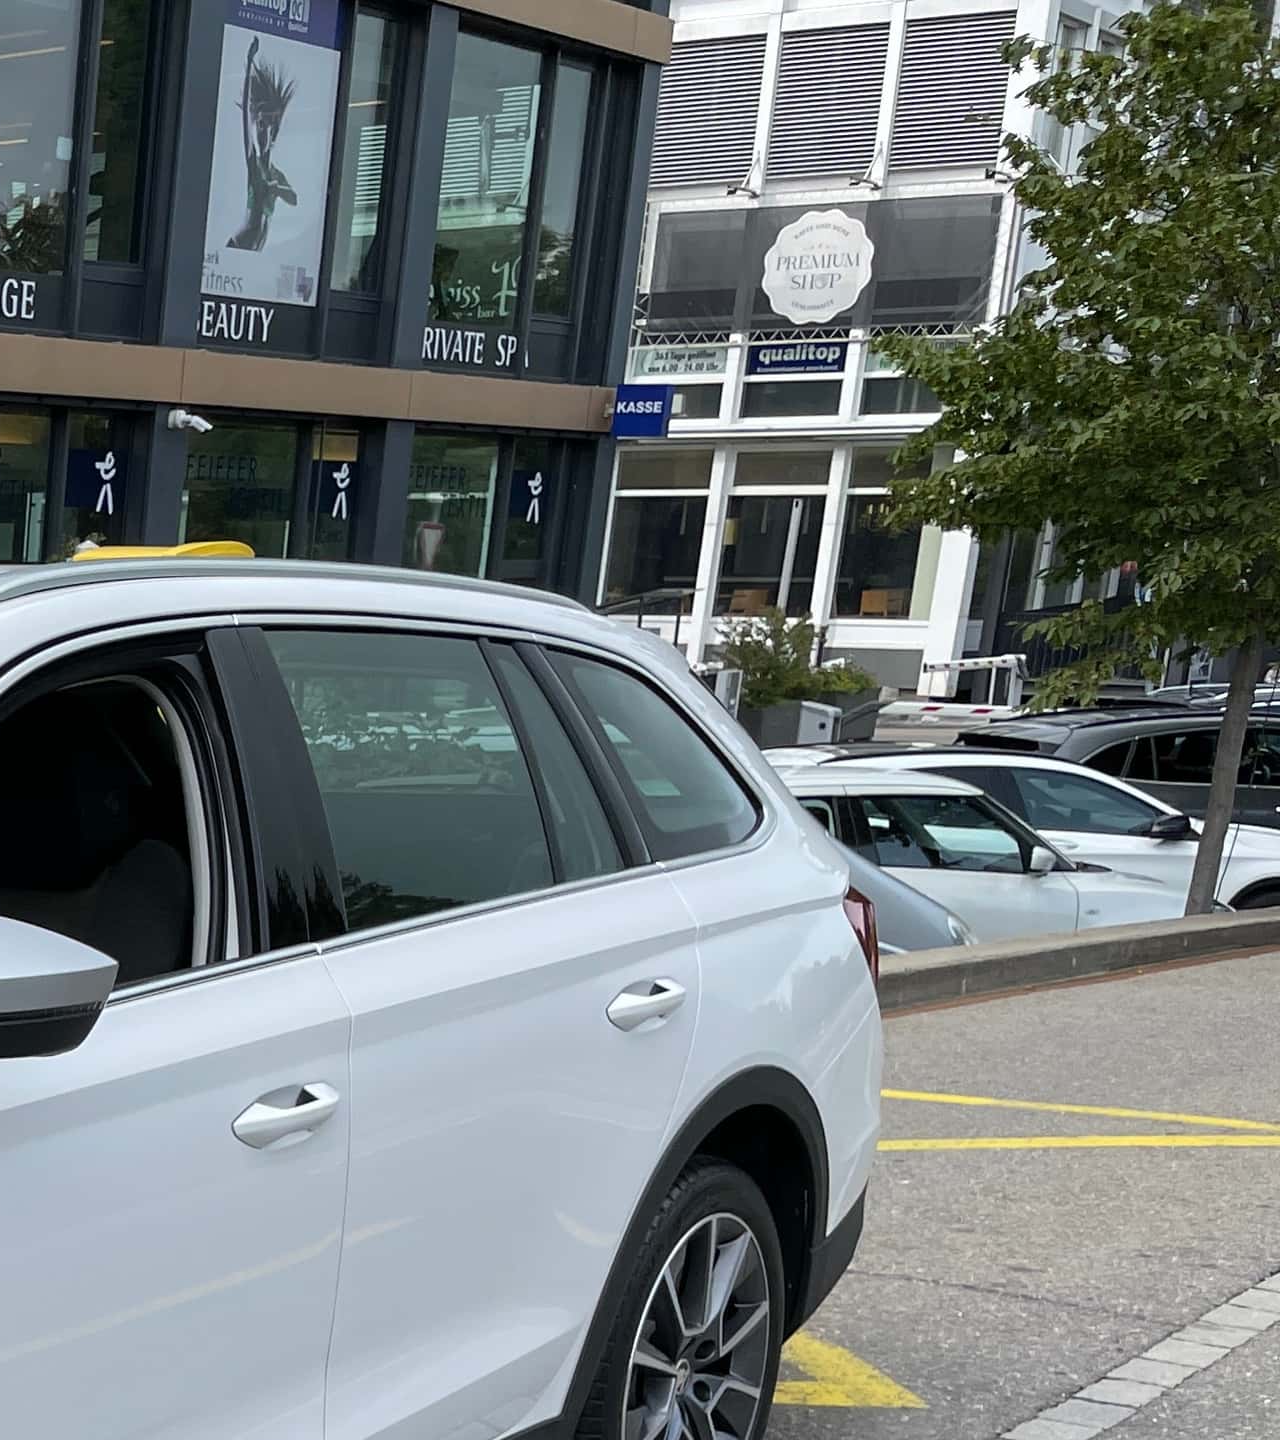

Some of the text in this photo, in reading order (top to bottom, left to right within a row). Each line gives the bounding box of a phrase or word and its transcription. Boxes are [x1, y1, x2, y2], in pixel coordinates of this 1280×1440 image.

[776, 252, 860, 272] PREMIUM
[790, 272, 842, 291] SHOP
[197, 301, 274, 342] EAUTY
[495, 334, 529, 369] SP
[758, 344, 842, 365] qualitop
[617, 401, 664, 414] KASSE
